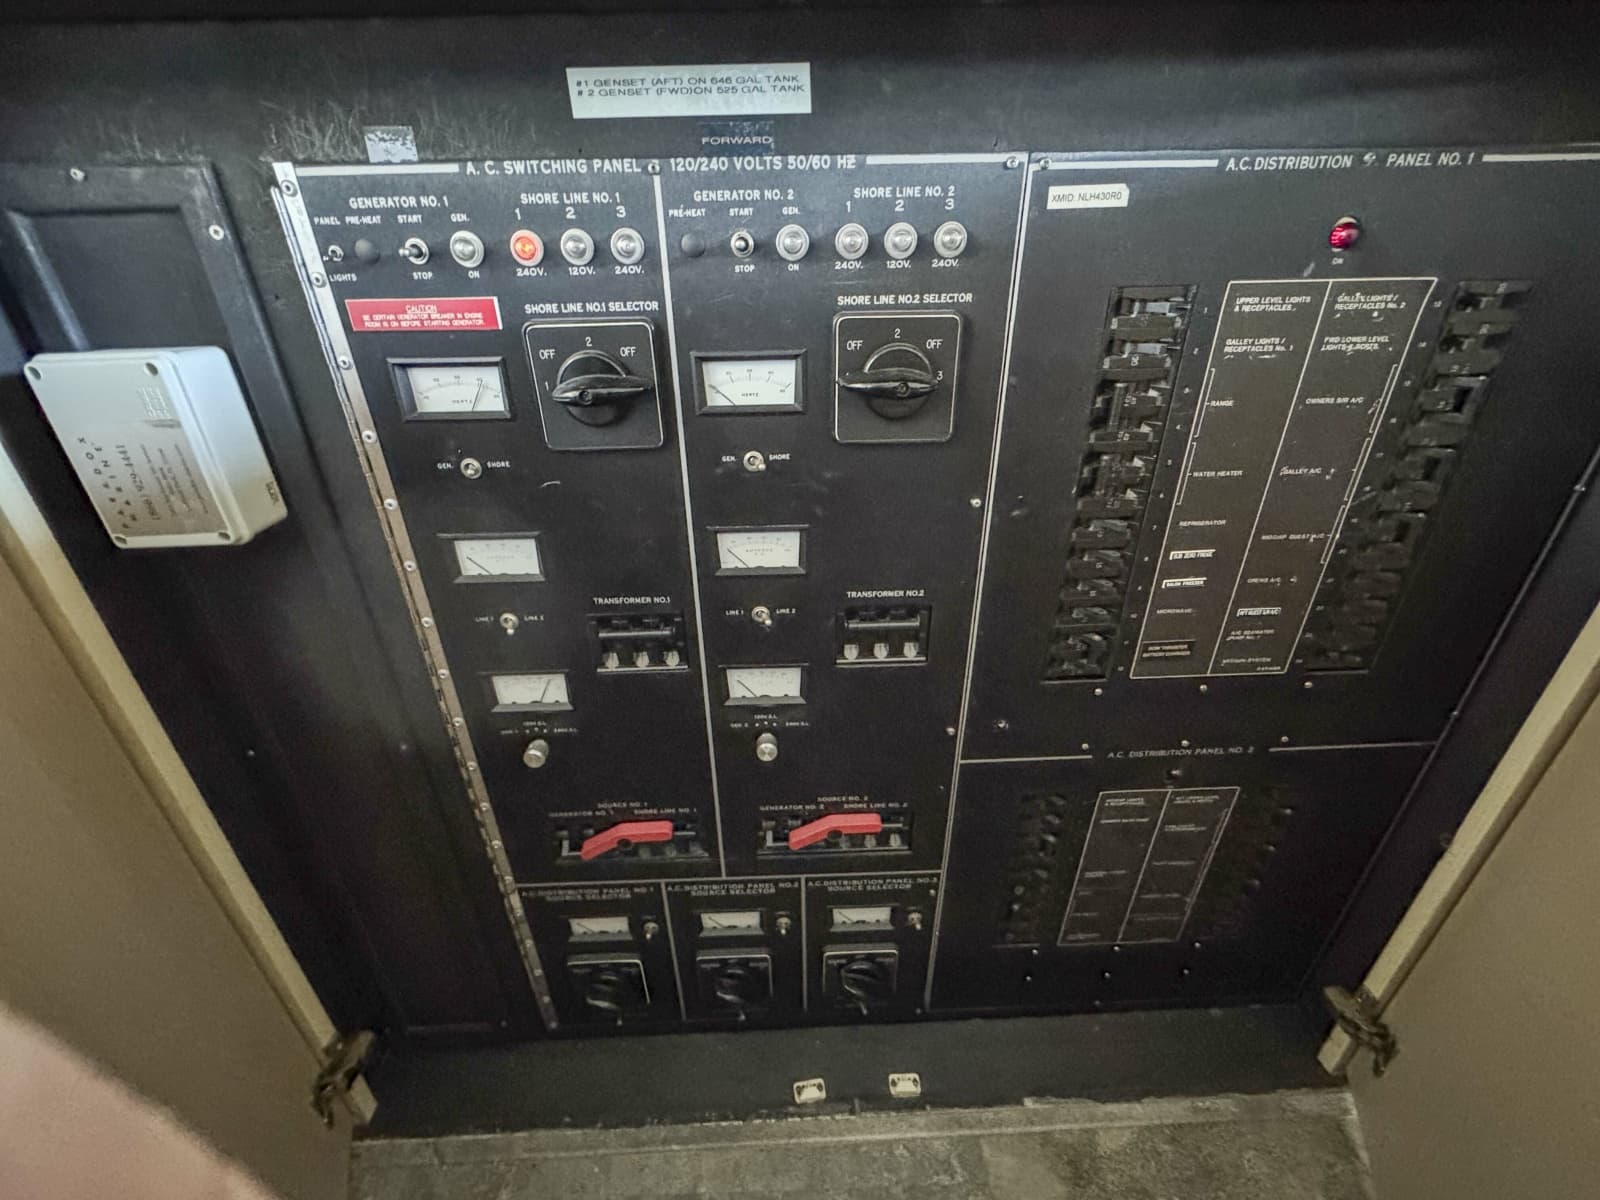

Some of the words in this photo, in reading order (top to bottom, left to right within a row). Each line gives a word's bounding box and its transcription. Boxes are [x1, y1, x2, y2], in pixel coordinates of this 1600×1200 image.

[594, 79, 645, 87] GENSET
[651, 78, 683, 86] (AFT)
[687, 77, 706, 85] ON
[765, 75, 799, 83] TANK
[599, 88, 649, 96] GENSET
[702, 136, 772, 145] FORWARD
[504, 159, 587, 175] SWITCHING
[593, 158, 641, 173] PANEL
[670, 157, 728, 172] 120/240
[734, 156, 782, 170] VOLTS
[787, 155, 831, 169] 50/60
[1254, 155, 1353, 170] DISTRIBUTION
[1386, 152, 1432, 167] PANEL
[1438, 152, 1461, 166] NO.
[1467, 152, 1475, 165] 1
[694, 189, 760, 202] GENERATOR
[764, 189, 784, 200] NO.
[787, 189, 794, 200] 2
[854, 187, 892, 199] SHORE
[896, 186, 921, 198] LINE
[925, 186, 944, 197] NO.
[948, 185, 955, 196] 2
[349, 196, 417, 209] GENERATOR
[421, 196, 441, 208] NO.
[443, 196, 448, 207] 1
[520, 193, 559, 205] SHORE
[563, 192, 590, 204] LINE
[592, 192, 612, 203] NO.
[615, 192, 620, 203] 1
[846, 201, 851, 212] 1
[895, 200, 904, 212] 2
[945, 198, 954, 210] 3
[514, 208, 521, 220] 1
[566, 207, 576, 219] 2
[616, 206, 626, 218] 3
[729, 208, 753, 216] START
[314, 216, 340, 225] PANEL
[345, 215, 381, 224] PRE-HEAT
[397, 214, 422, 223] START
[451, 213, 470, 222] GEN.
[835, 261, 863, 270] 240V.
[886, 260, 911, 269] 120V.
[932, 259, 959, 267] 240V.
[516, 268, 547, 277] 240V.
[569, 267, 596, 276] 120V.
[615, 266, 645, 275] 240V.
[734, 265, 755, 273] STOP
[788, 264, 799, 272] ON
[329, 273, 357, 282] LIGHTS
[413, 271, 433, 280] STOP
[468, 271, 479, 279] ON
[837, 295, 871, 305] SHORE
[874, 295, 895, 304] LINE
[898, 294, 920, 303] NO.2
[923, 293, 973, 303] SELECTOR
[405, 305, 437, 313] CAUTION
[524, 304, 559, 314] SHORE
[562, 304, 584, 313] LINE
[586, 303, 606, 313] NO.1
[609, 301, 659, 312] SELECTOR
[894, 329, 901, 339] 2
[585, 337, 592, 347] 2
[846, 340, 863, 351] OFF
[926, 339, 943, 349] OFF
[539, 350, 556, 360] OFF
[620, 347, 636, 357] OFF
[937, 371, 943, 380] 3
[847, 590, 904, 598] TRANSFORMER
[593, 597, 651, 605] TRANSFORMER
[1129, 749, 1192, 758] DISTRIBUTION
